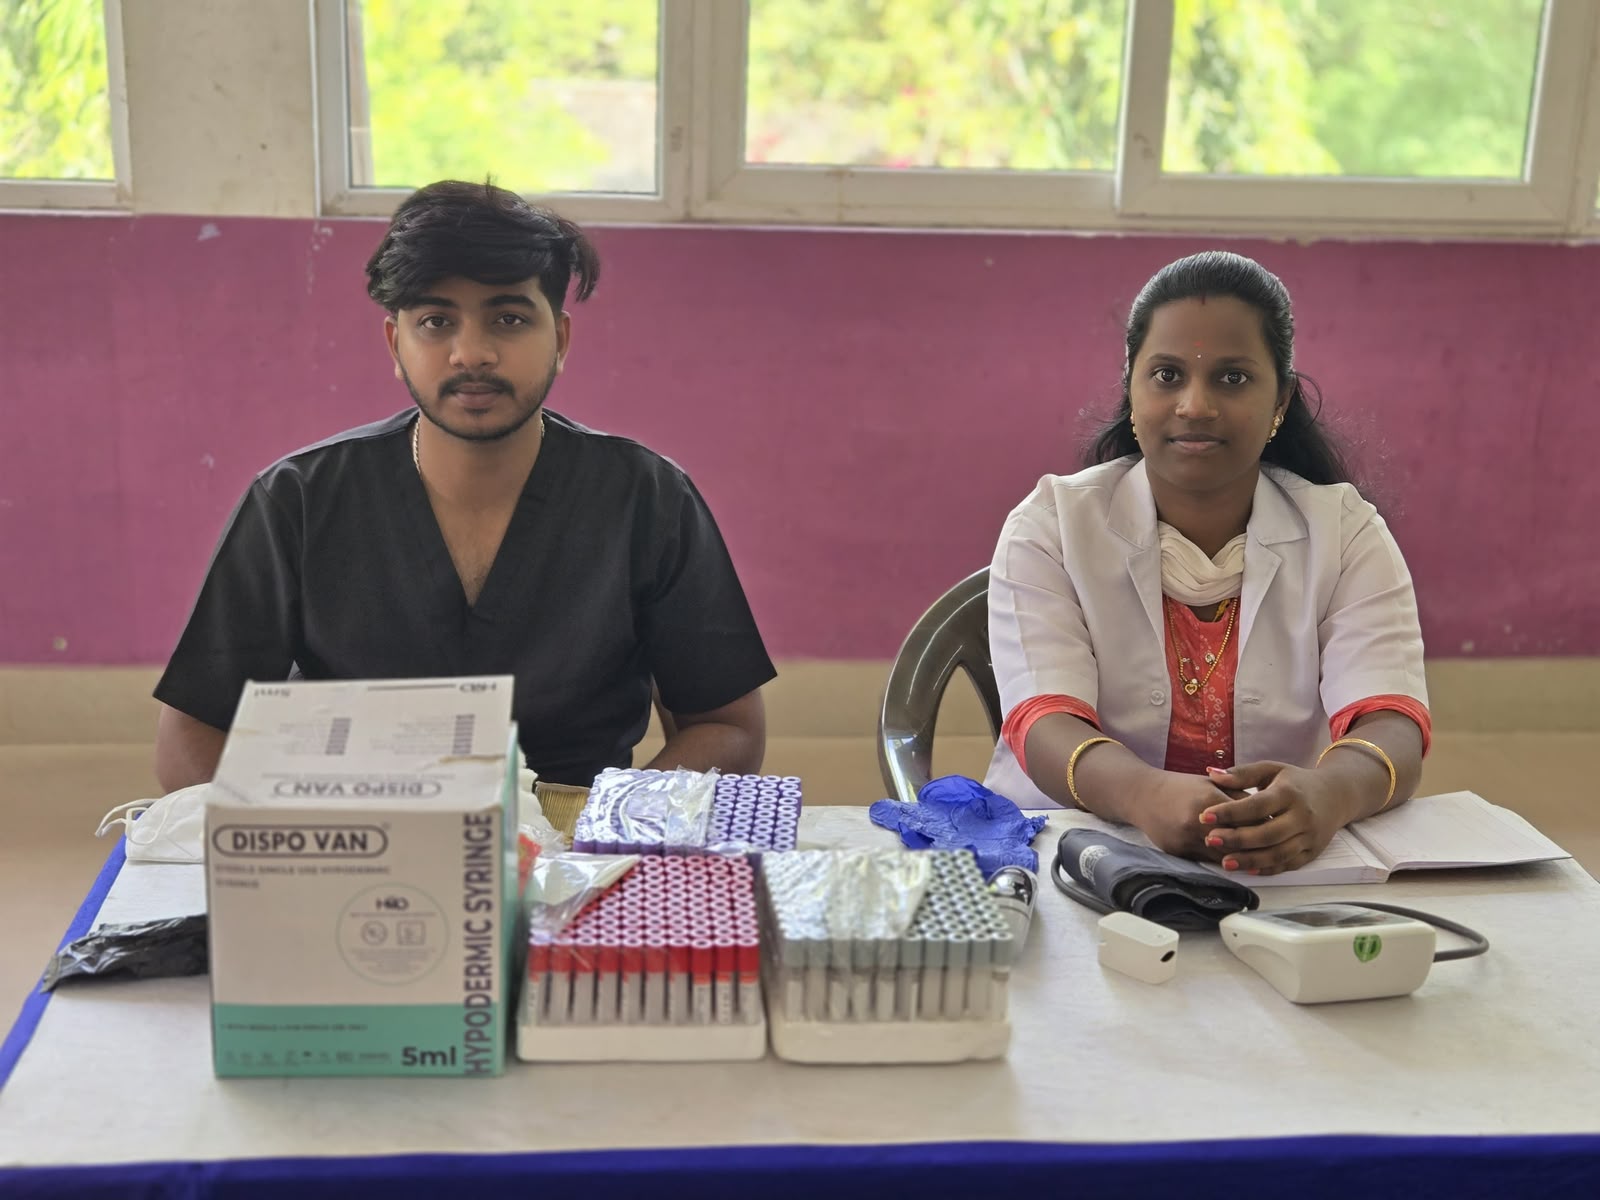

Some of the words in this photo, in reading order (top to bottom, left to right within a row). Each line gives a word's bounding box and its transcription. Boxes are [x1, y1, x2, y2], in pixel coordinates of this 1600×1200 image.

[294, 783, 346, 797] VAN
[353, 783, 423, 797] DISPO
[232, 831, 306, 852] DISPO
[314, 831, 368, 852] VAN
[463, 812, 493, 913] SYRINGE
[463, 919, 493, 1075] HYPODERMIC
[401, 1046, 457, 1068] 5ml
